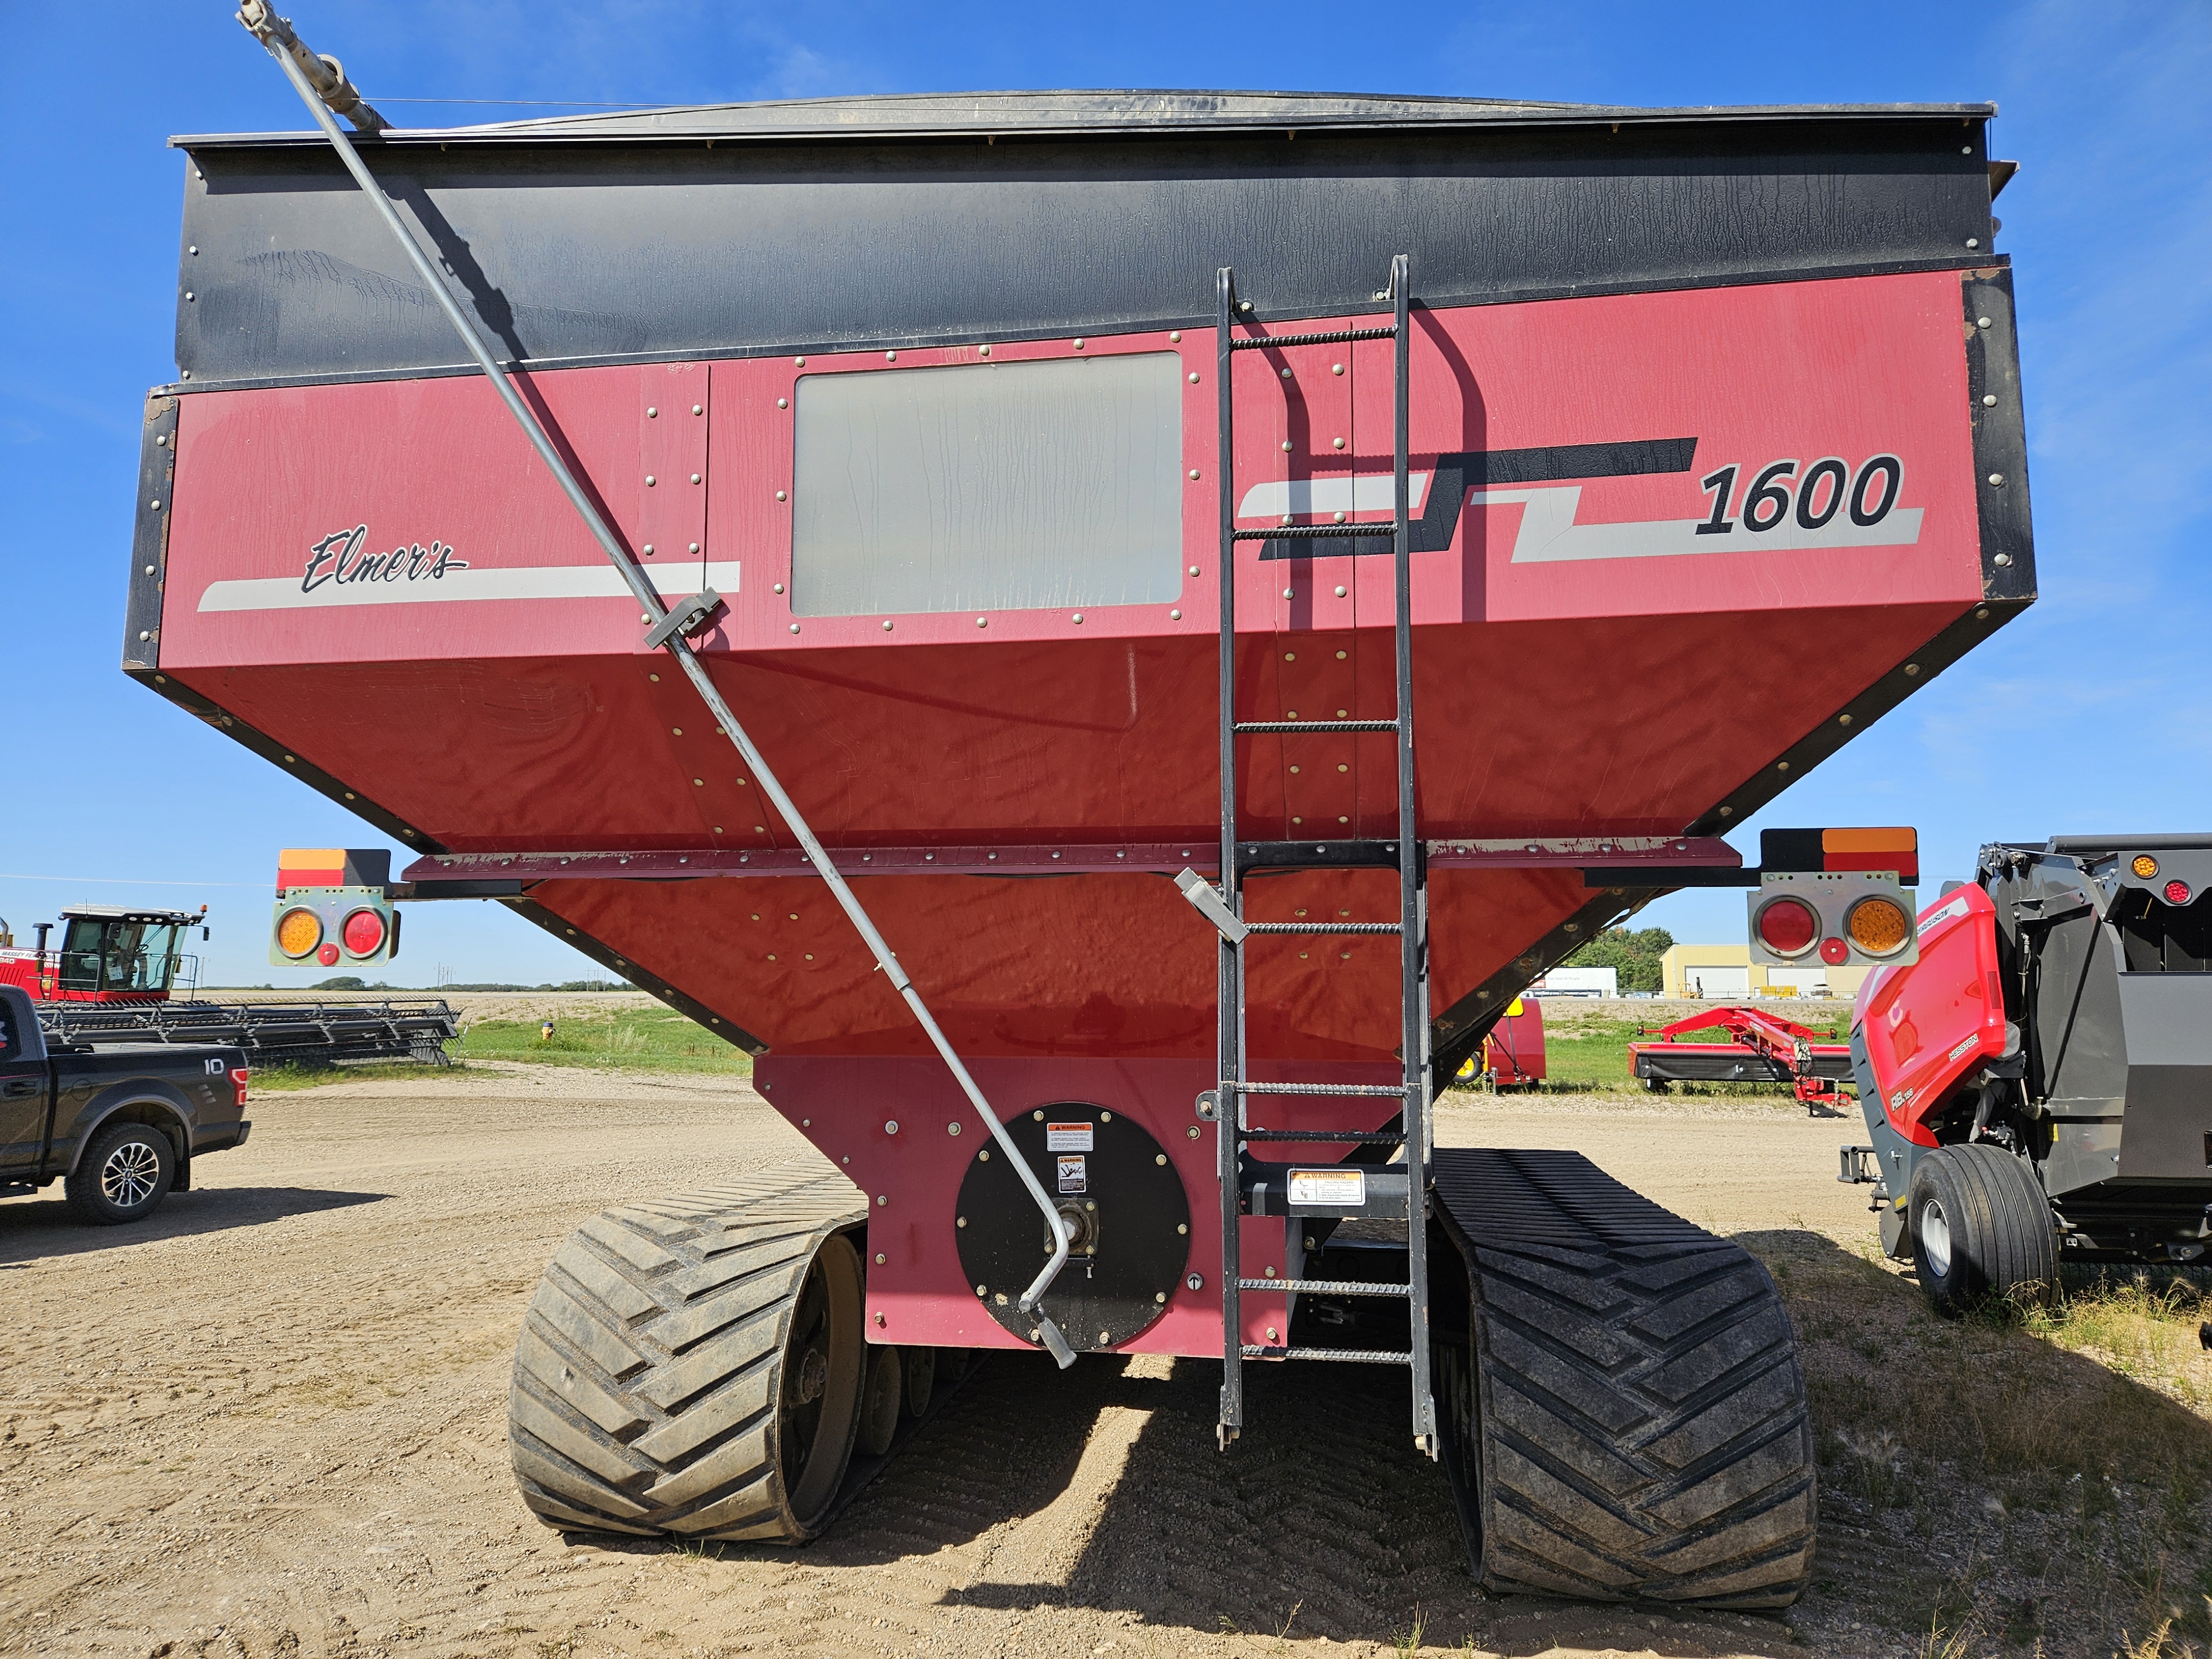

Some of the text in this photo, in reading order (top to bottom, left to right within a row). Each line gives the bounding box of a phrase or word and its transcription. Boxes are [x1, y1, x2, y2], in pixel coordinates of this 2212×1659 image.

[1694, 455, 1902, 535] 1600
[301, 524, 468, 593] Elmer's
[1917, 907, 1950, 935] ERGUSON
[1949, 1034, 1979, 1062] HESSTON
[205, 1058, 224, 1074] 10
